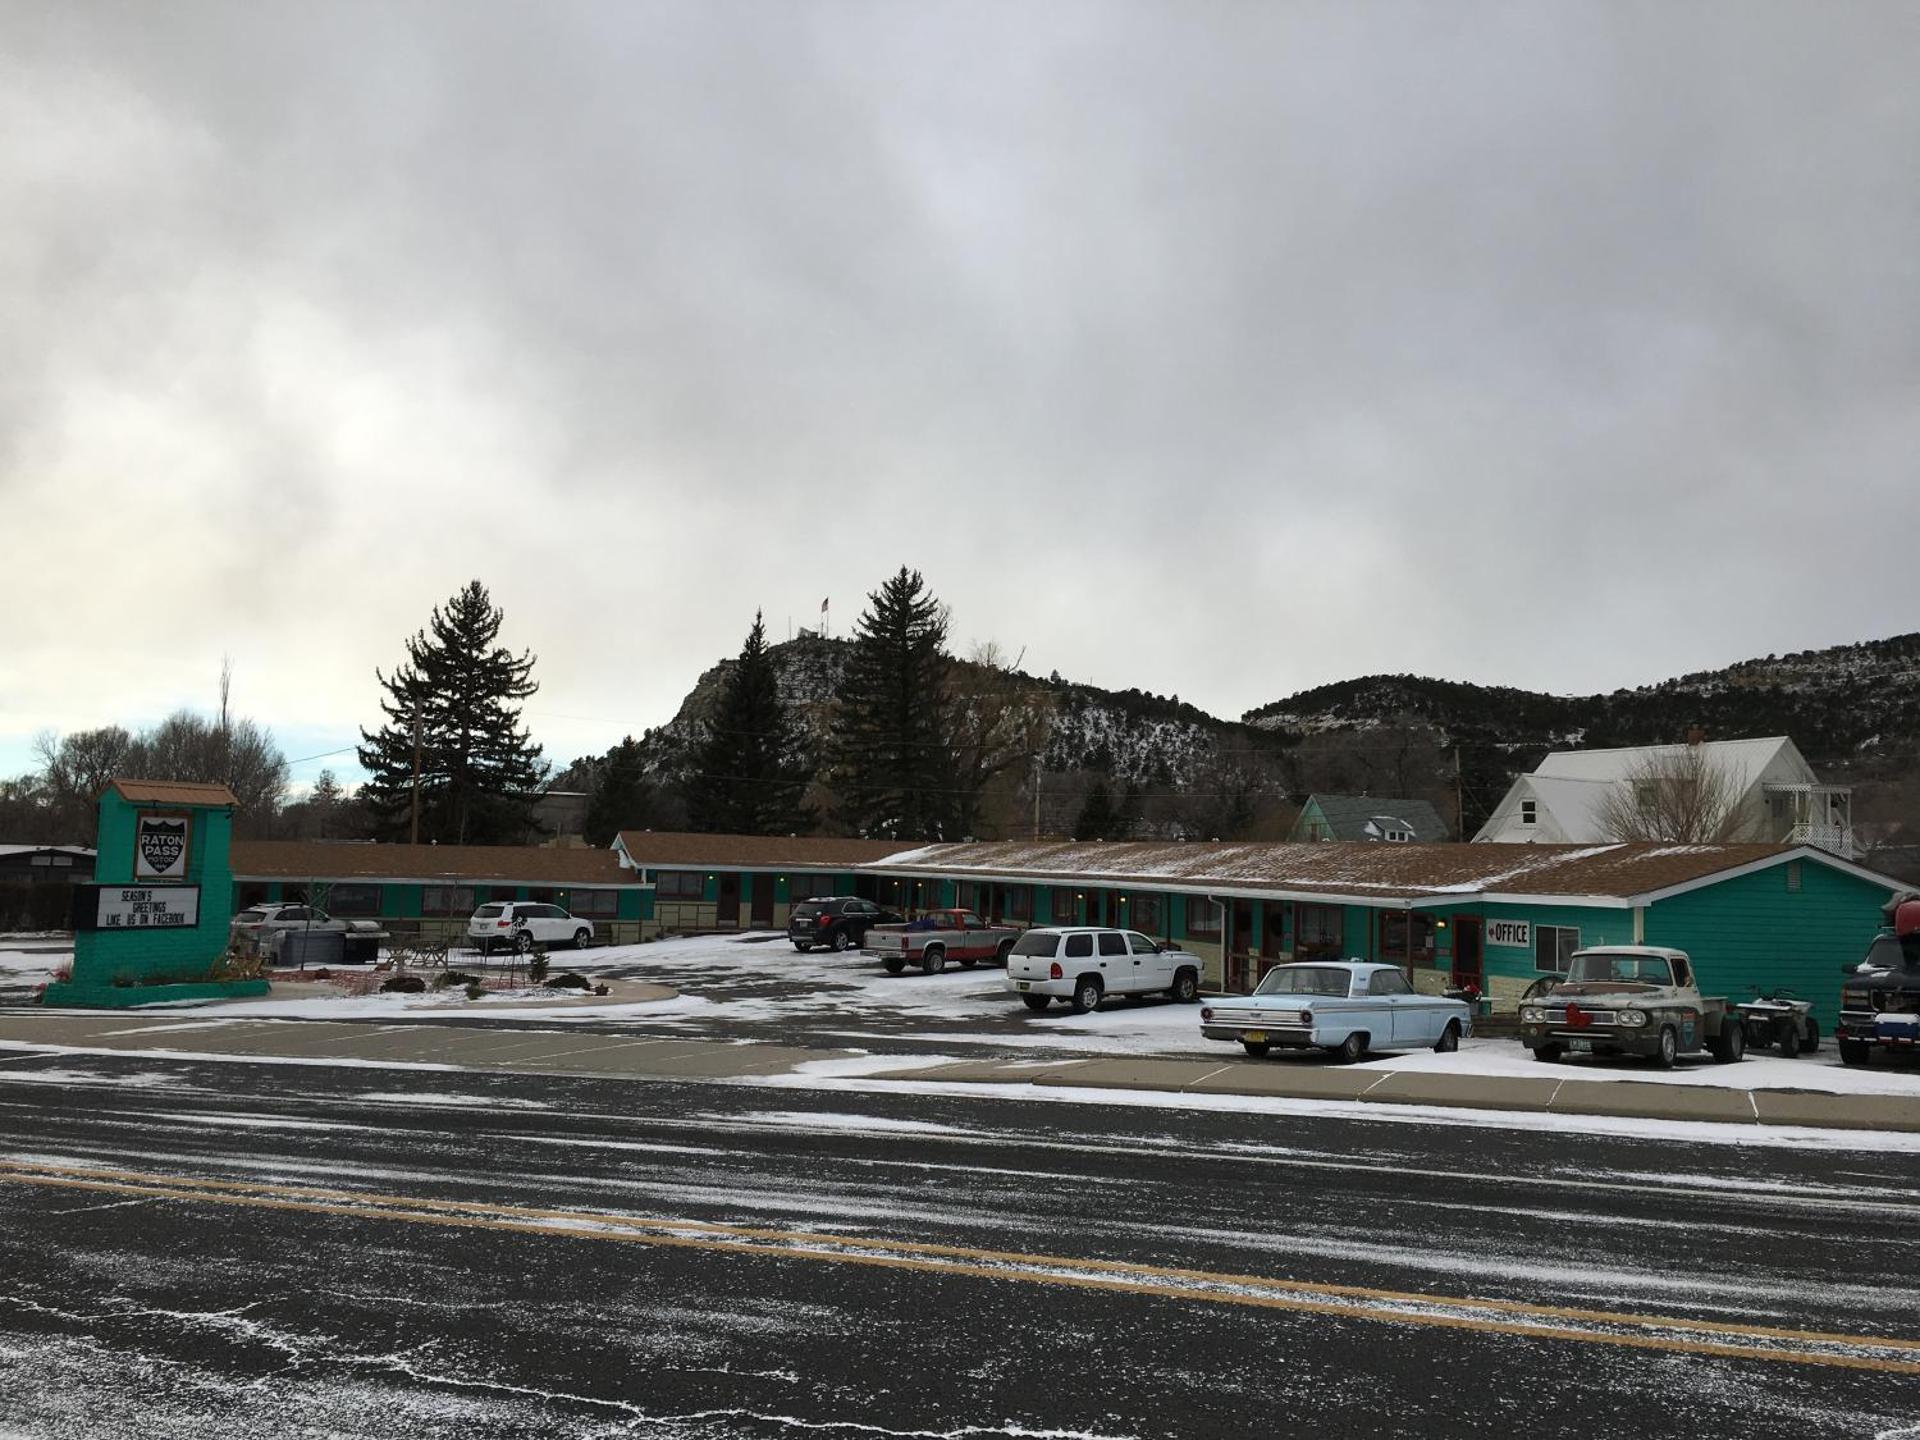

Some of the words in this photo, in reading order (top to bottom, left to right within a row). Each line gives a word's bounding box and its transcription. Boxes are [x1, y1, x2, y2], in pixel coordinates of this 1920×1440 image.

[141, 834, 184, 846] RATON
[145, 845, 179, 856] PASS
[133, 901, 166, 913] GREETINGS
[106, 914, 121, 926] LIKE
[127, 913, 136, 925] US
[153, 912, 185, 925] FACEBOOK
[1495, 923, 1528, 943] OFFICE
